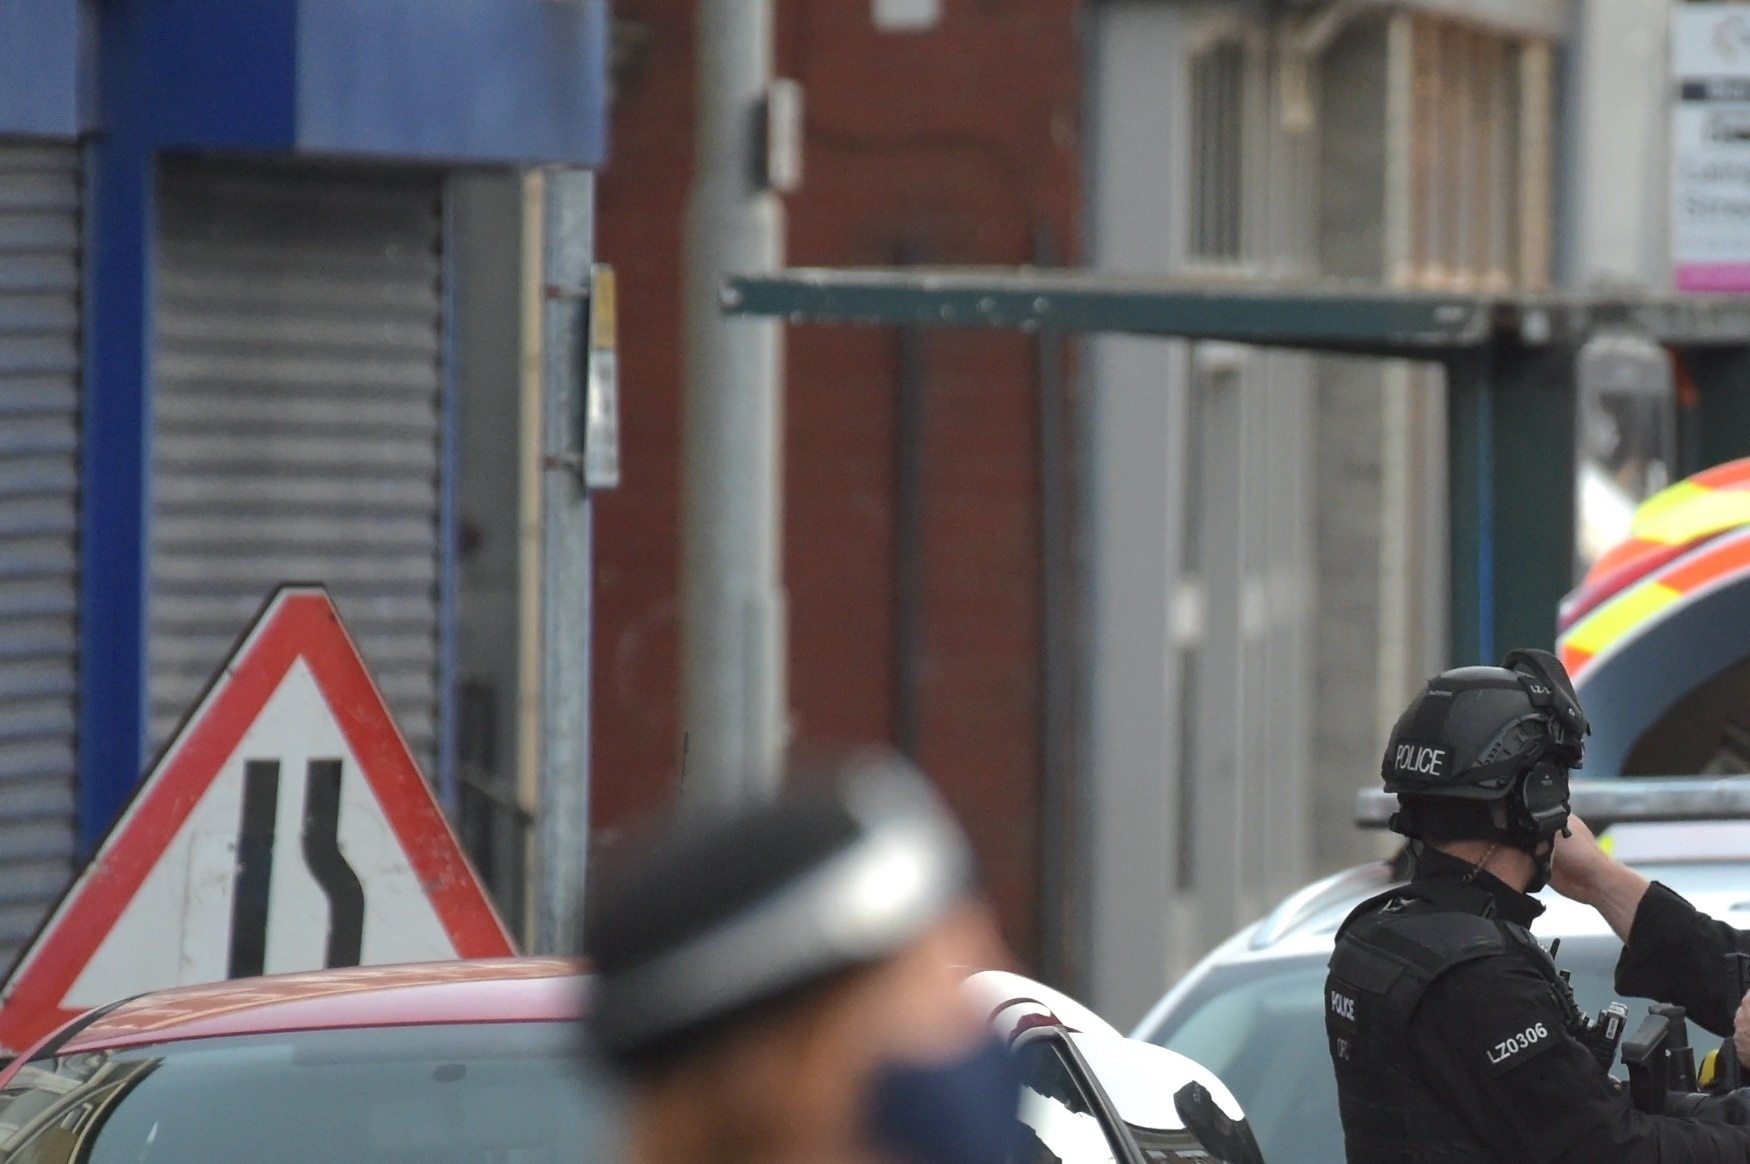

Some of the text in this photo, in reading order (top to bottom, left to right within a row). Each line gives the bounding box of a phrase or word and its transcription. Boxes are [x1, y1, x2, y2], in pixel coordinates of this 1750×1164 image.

[1395, 744, 1446, 776] POLICE
[1331, 990, 1355, 1022] POLICE
[1486, 1022, 1549, 1066] LZ0306
